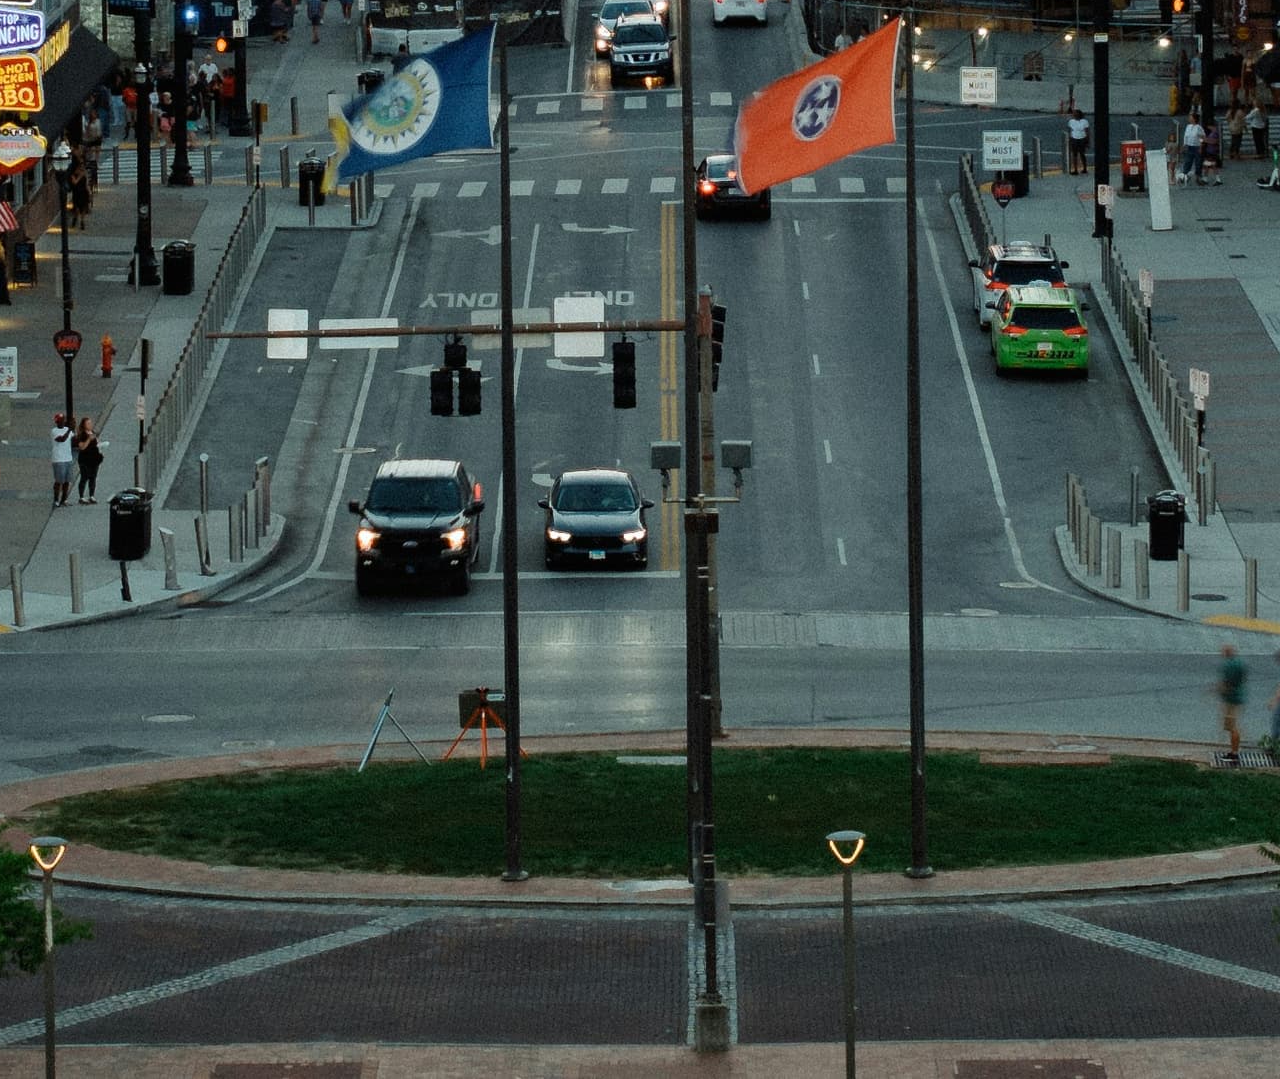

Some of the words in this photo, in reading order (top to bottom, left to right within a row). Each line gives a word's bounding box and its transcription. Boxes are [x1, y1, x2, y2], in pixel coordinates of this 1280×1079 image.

[6, 62, 30, 74] HOT
[968, 82, 988, 90] MUST
[991, 146, 1013, 155] MUST
[420, 292, 498, 308] ONLY
